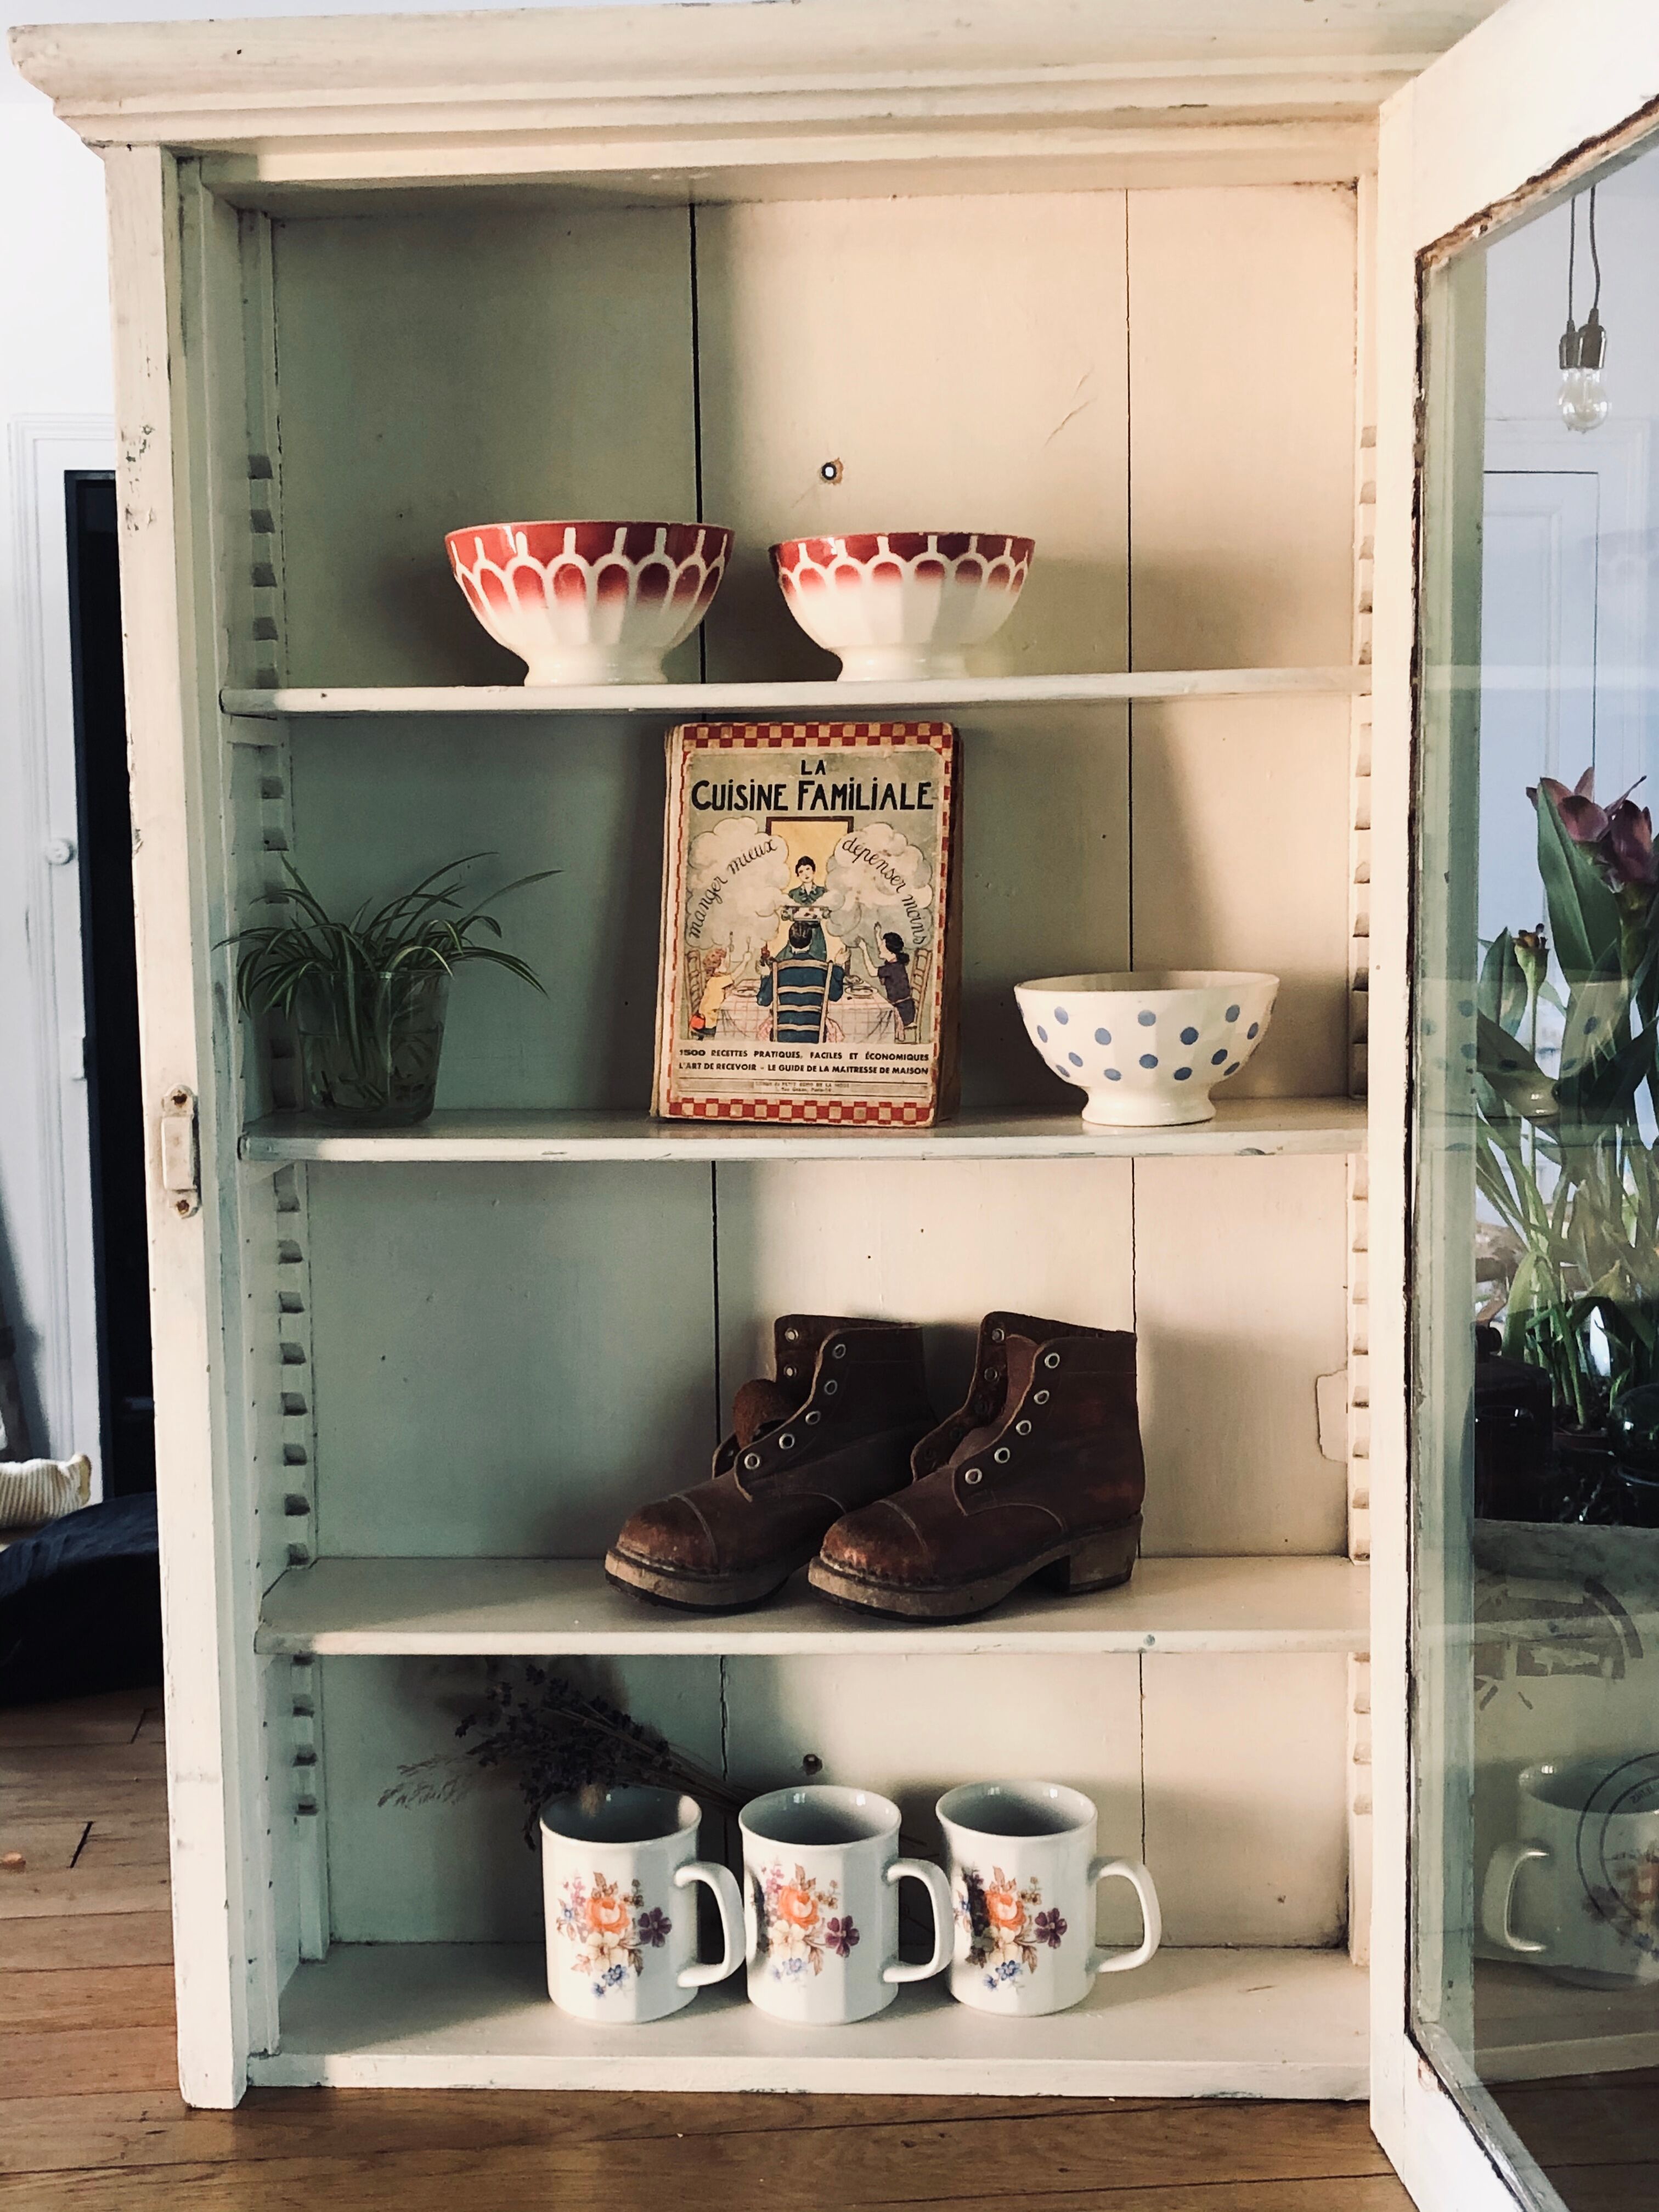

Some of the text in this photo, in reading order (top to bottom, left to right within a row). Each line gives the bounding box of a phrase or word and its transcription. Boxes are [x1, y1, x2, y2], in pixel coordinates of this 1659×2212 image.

[801, 760, 826, 775] LA
[691, 777, 934, 811] CUISINE FAMILIALE
[689, 839, 777, 939] manger mieux
[842, 837, 927, 945] dépenser moins
[865, 1051, 929, 1061] ÉCONOMIQUES
